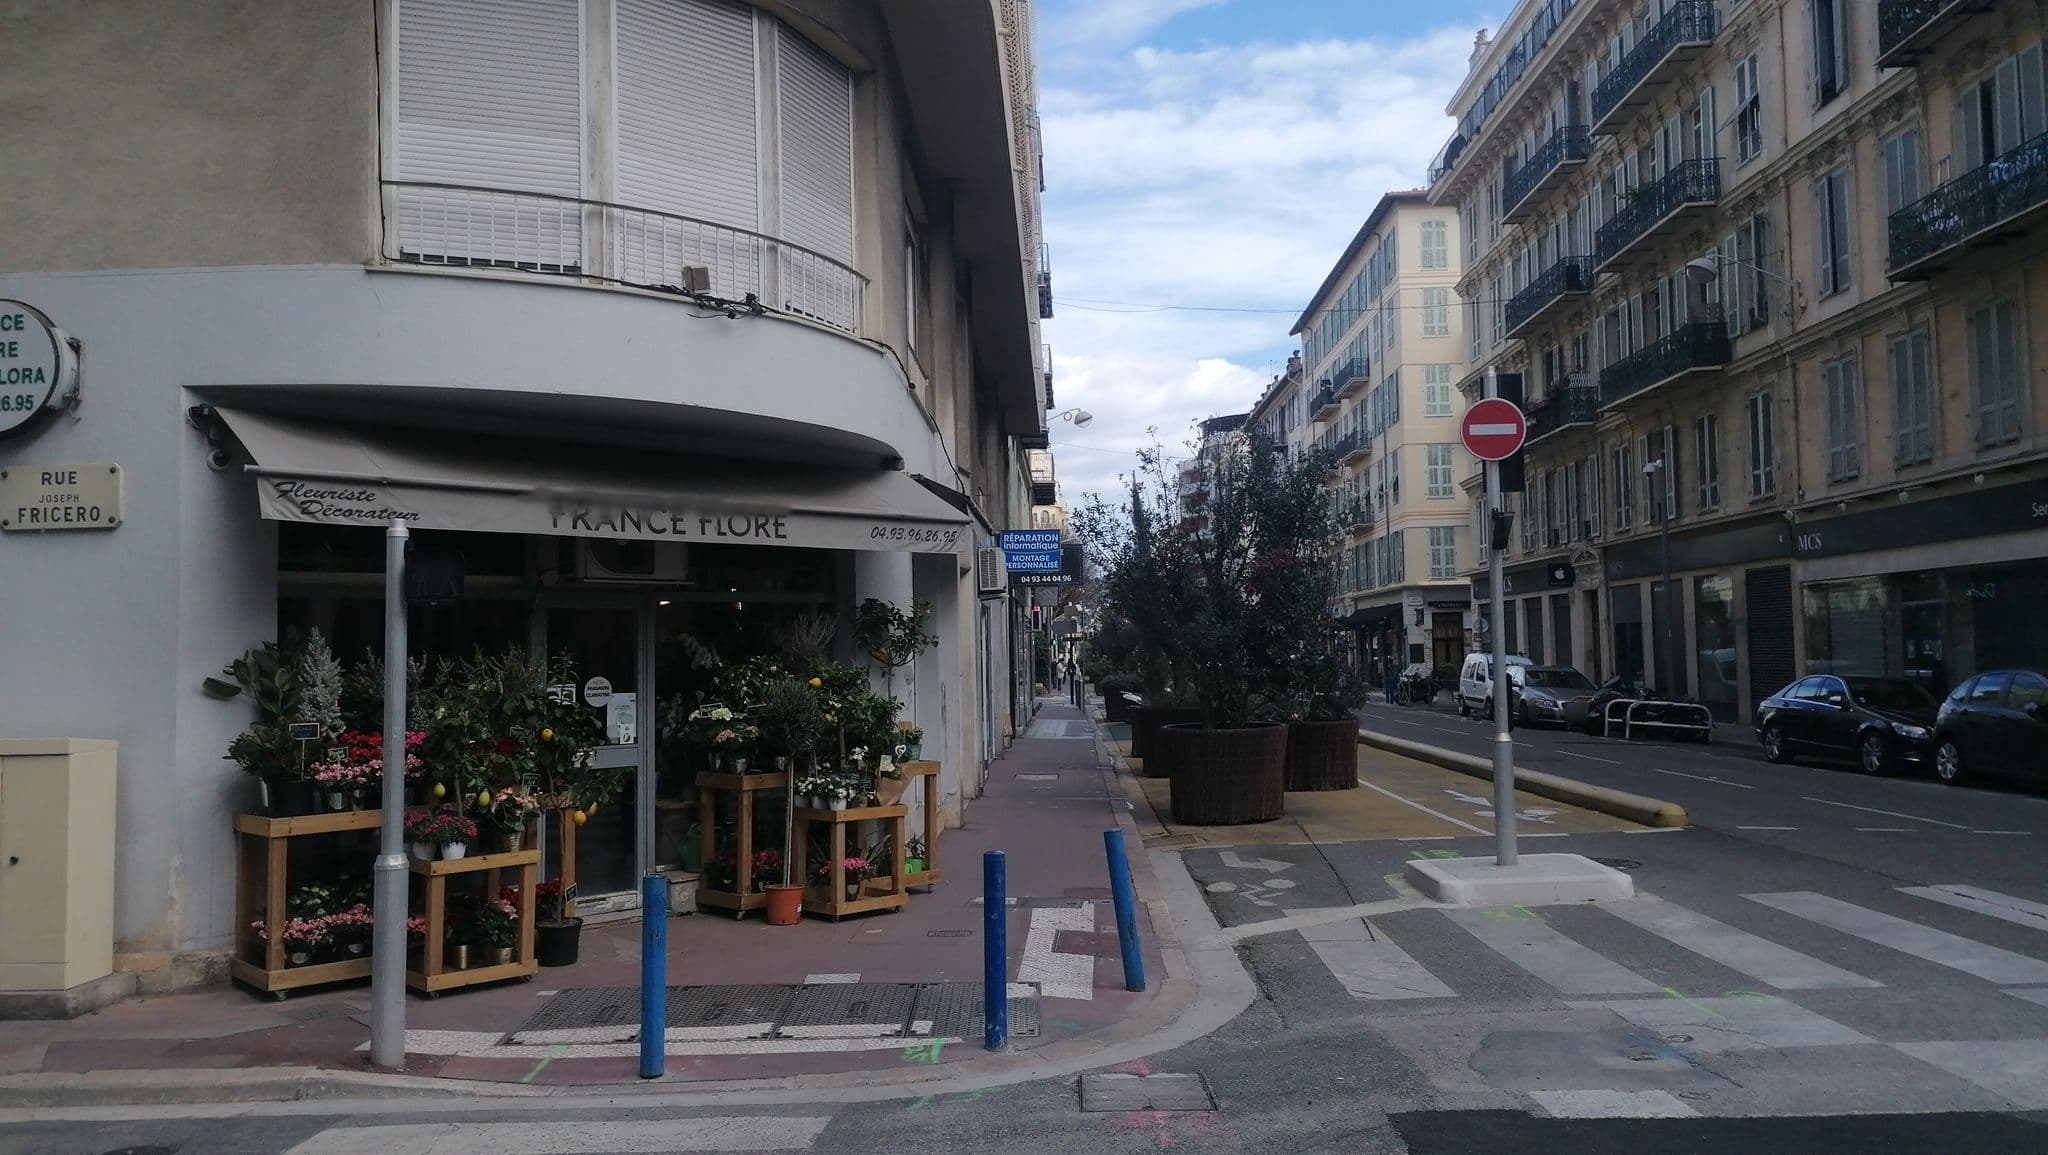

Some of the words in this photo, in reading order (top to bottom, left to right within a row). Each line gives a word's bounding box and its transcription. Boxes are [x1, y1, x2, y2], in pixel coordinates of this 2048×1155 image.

[1, 314, 24, 331] CE
[0, 395, 34, 412] 6.95
[41, 471, 78, 485] RUE
[39, 494, 80, 504] JOSEPH
[273, 480, 377, 503] Fleuriste
[18, 506, 101, 524] FRICERO
[300, 499, 421, 522] Décorateur
[870, 526, 958, 543] 04.93.96.26.95
[1003, 533, 1058, 542] RÉPARATION
[1798, 532, 1823, 551] MCS
[1003, 542, 1059, 551] informatique
[1503, 575, 1512, 592] CS
